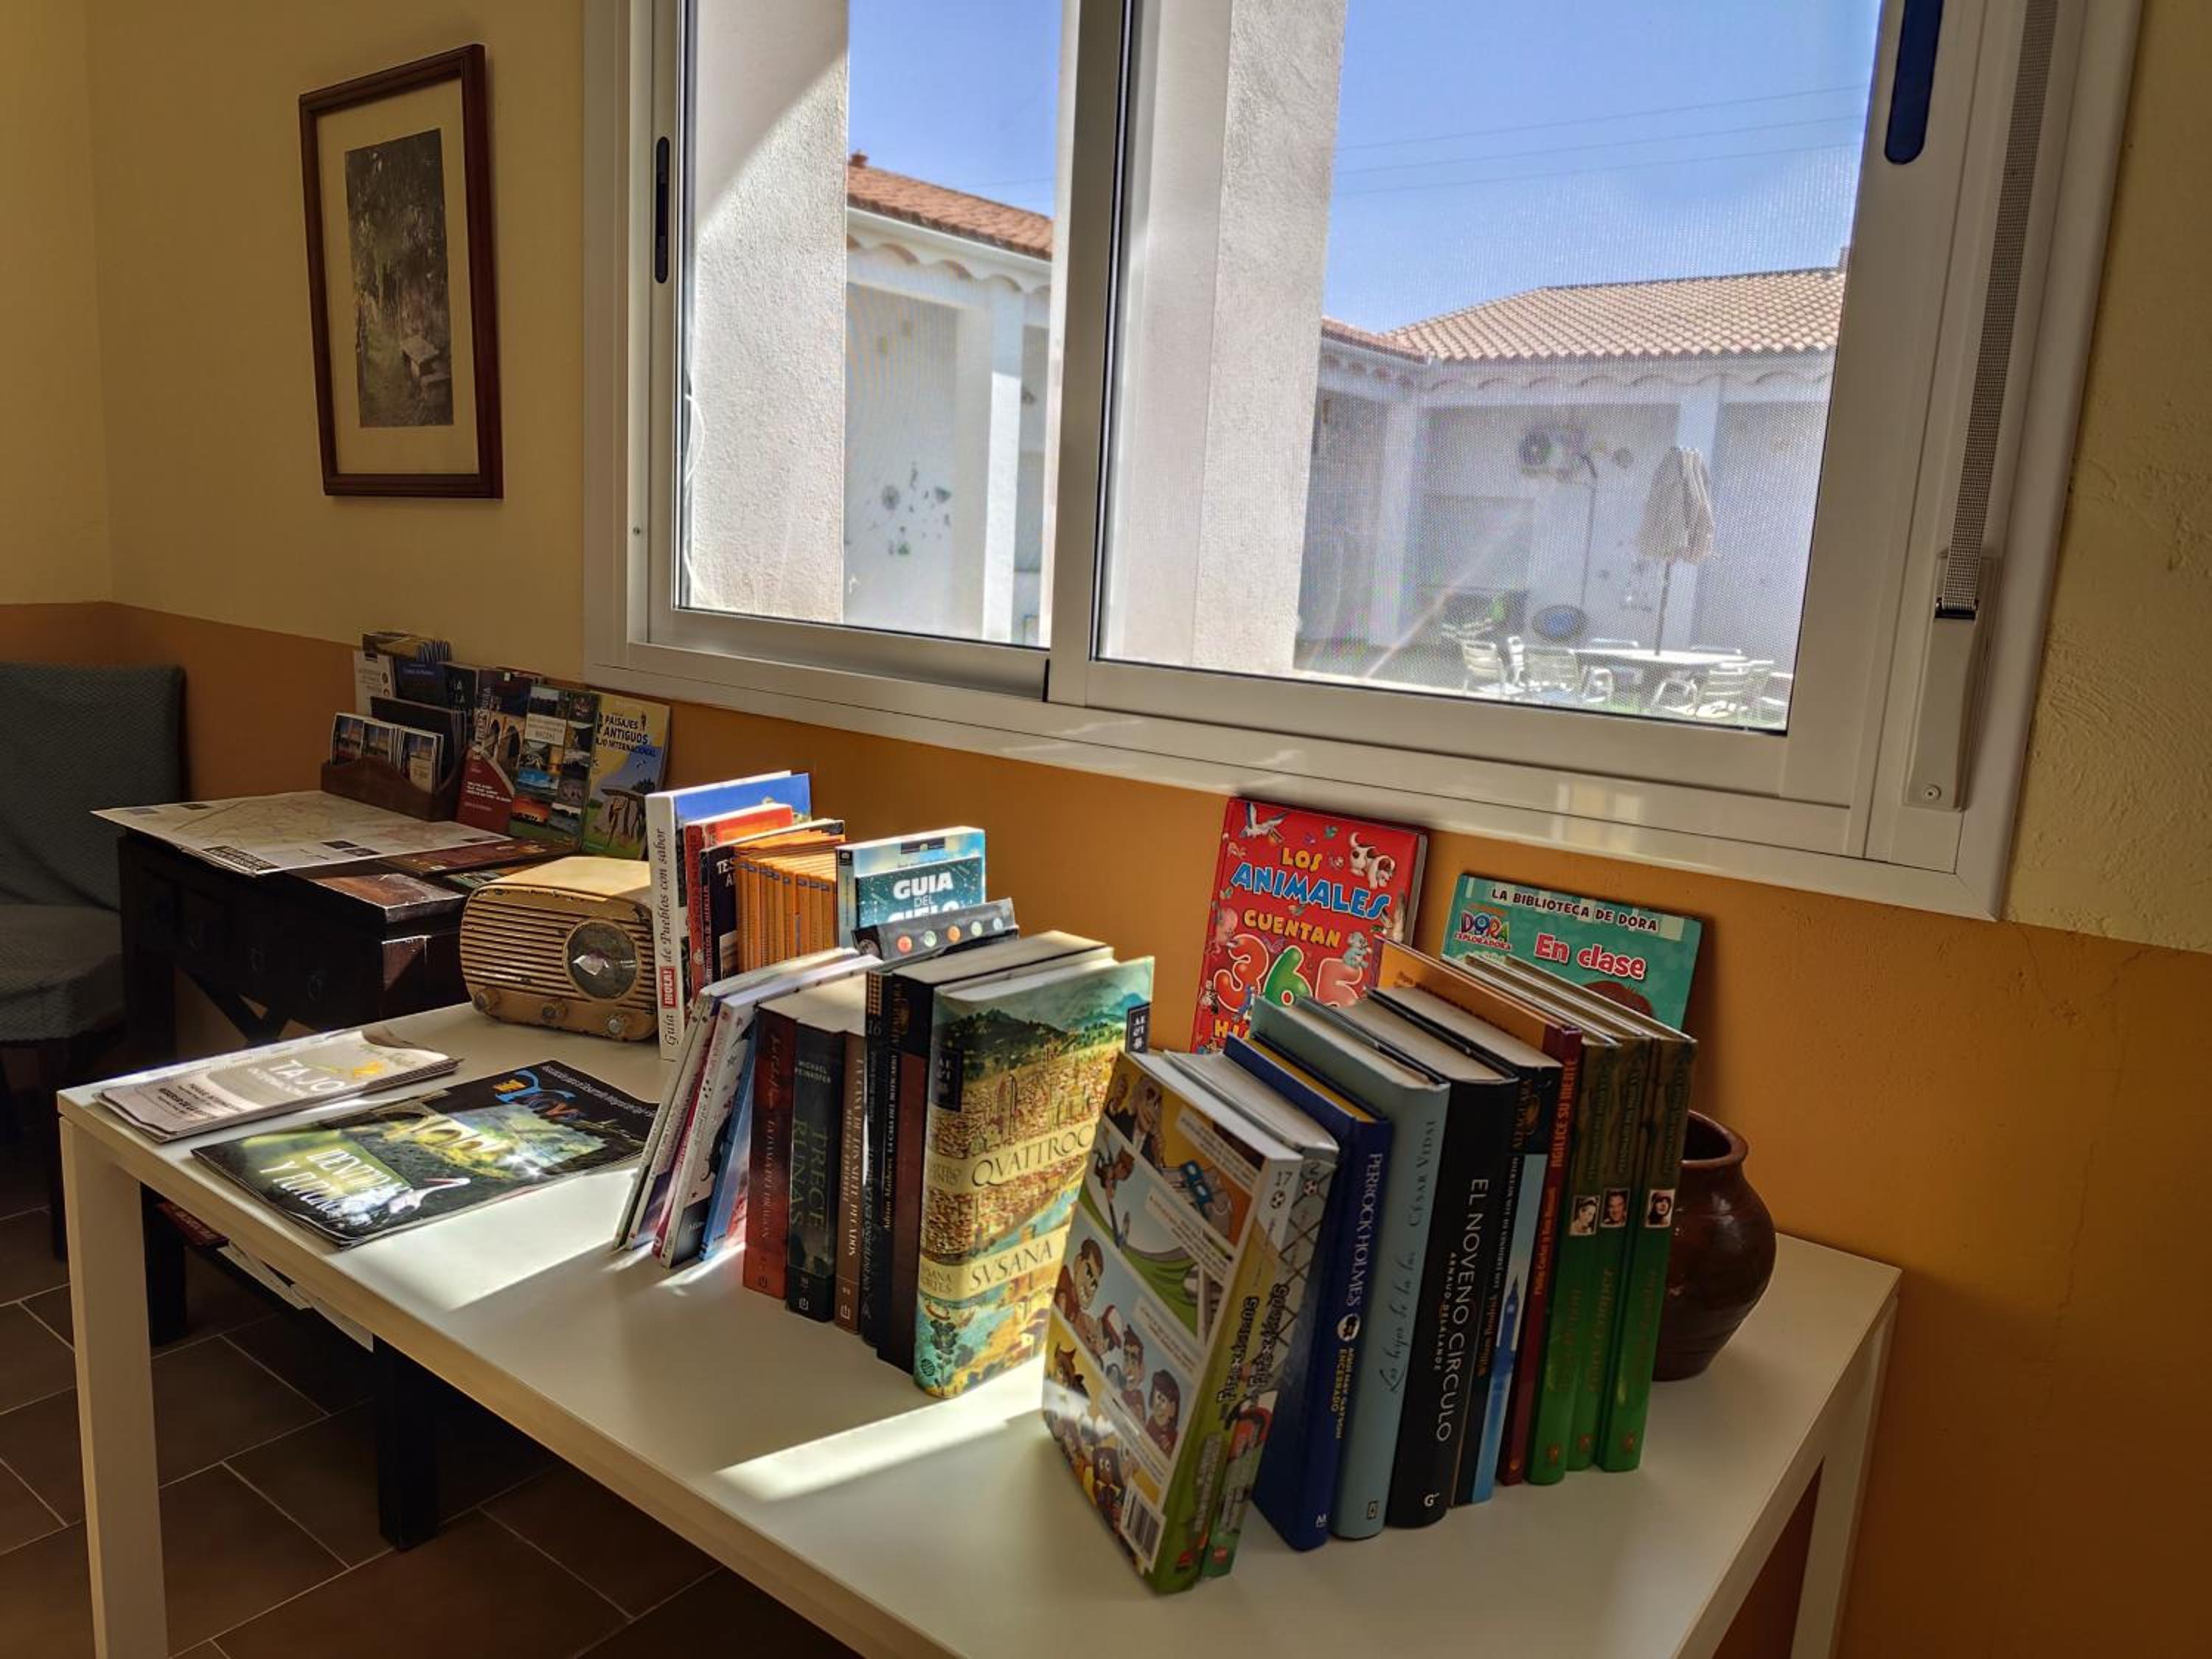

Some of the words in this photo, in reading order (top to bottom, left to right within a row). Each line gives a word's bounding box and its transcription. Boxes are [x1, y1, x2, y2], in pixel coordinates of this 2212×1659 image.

[603, 726, 649, 745] ANTIGUOS
[605, 713, 639, 729] PAISAJES
[653, 828, 667, 864] sabor
[1280, 848, 1322, 872] LOS
[658, 868, 668, 890] con
[893, 872, 954, 900] GUIA
[1231, 862, 1391, 920] ANIMALES
[657, 894, 670, 944] Pueblos
[914, 896, 933, 908] DEL
[1492, 889, 1507, 900] LA
[1513, 893, 1590, 917] BIBLIOTECA
[1596, 908, 1613, 921] DE
[1619, 914, 1658, 931] DORA
[1244, 910, 1341, 947] CUENTAN
[1461, 911, 1509, 943] DORA
[661, 948, 672, 962] de
[1214, 933, 1363, 1012] 365
[1535, 933, 1570, 963] En
[1578, 944, 1646, 979] clase
[268, 1060, 346, 1093] TAJO
[799, 1060, 827, 1074] MICHAEL
[1557, 1102, 1570, 1119] SU
[1551, 1119, 1568, 1168] AGILICE
[260, 1160, 300, 1174] Y
[790, 1119, 809, 1225] RUNAS
[810, 1130, 827, 1227] TRECE
[1274, 1170, 1293, 1186] 17
[1360, 1152, 1382, 1234] PERROCK
[1470, 1177, 1489, 1207] EL
[848, 1203, 859, 1256] PECADOS
[1346, 1234, 1370, 1308] HOLMES
[1443, 1251, 1457, 1299] ARNAUD
[1452, 1213, 1484, 1325] NOVENO
[1433, 1305, 1450, 1371] DELALANDE
[1435, 1331, 1466, 1442] CIRCULO
